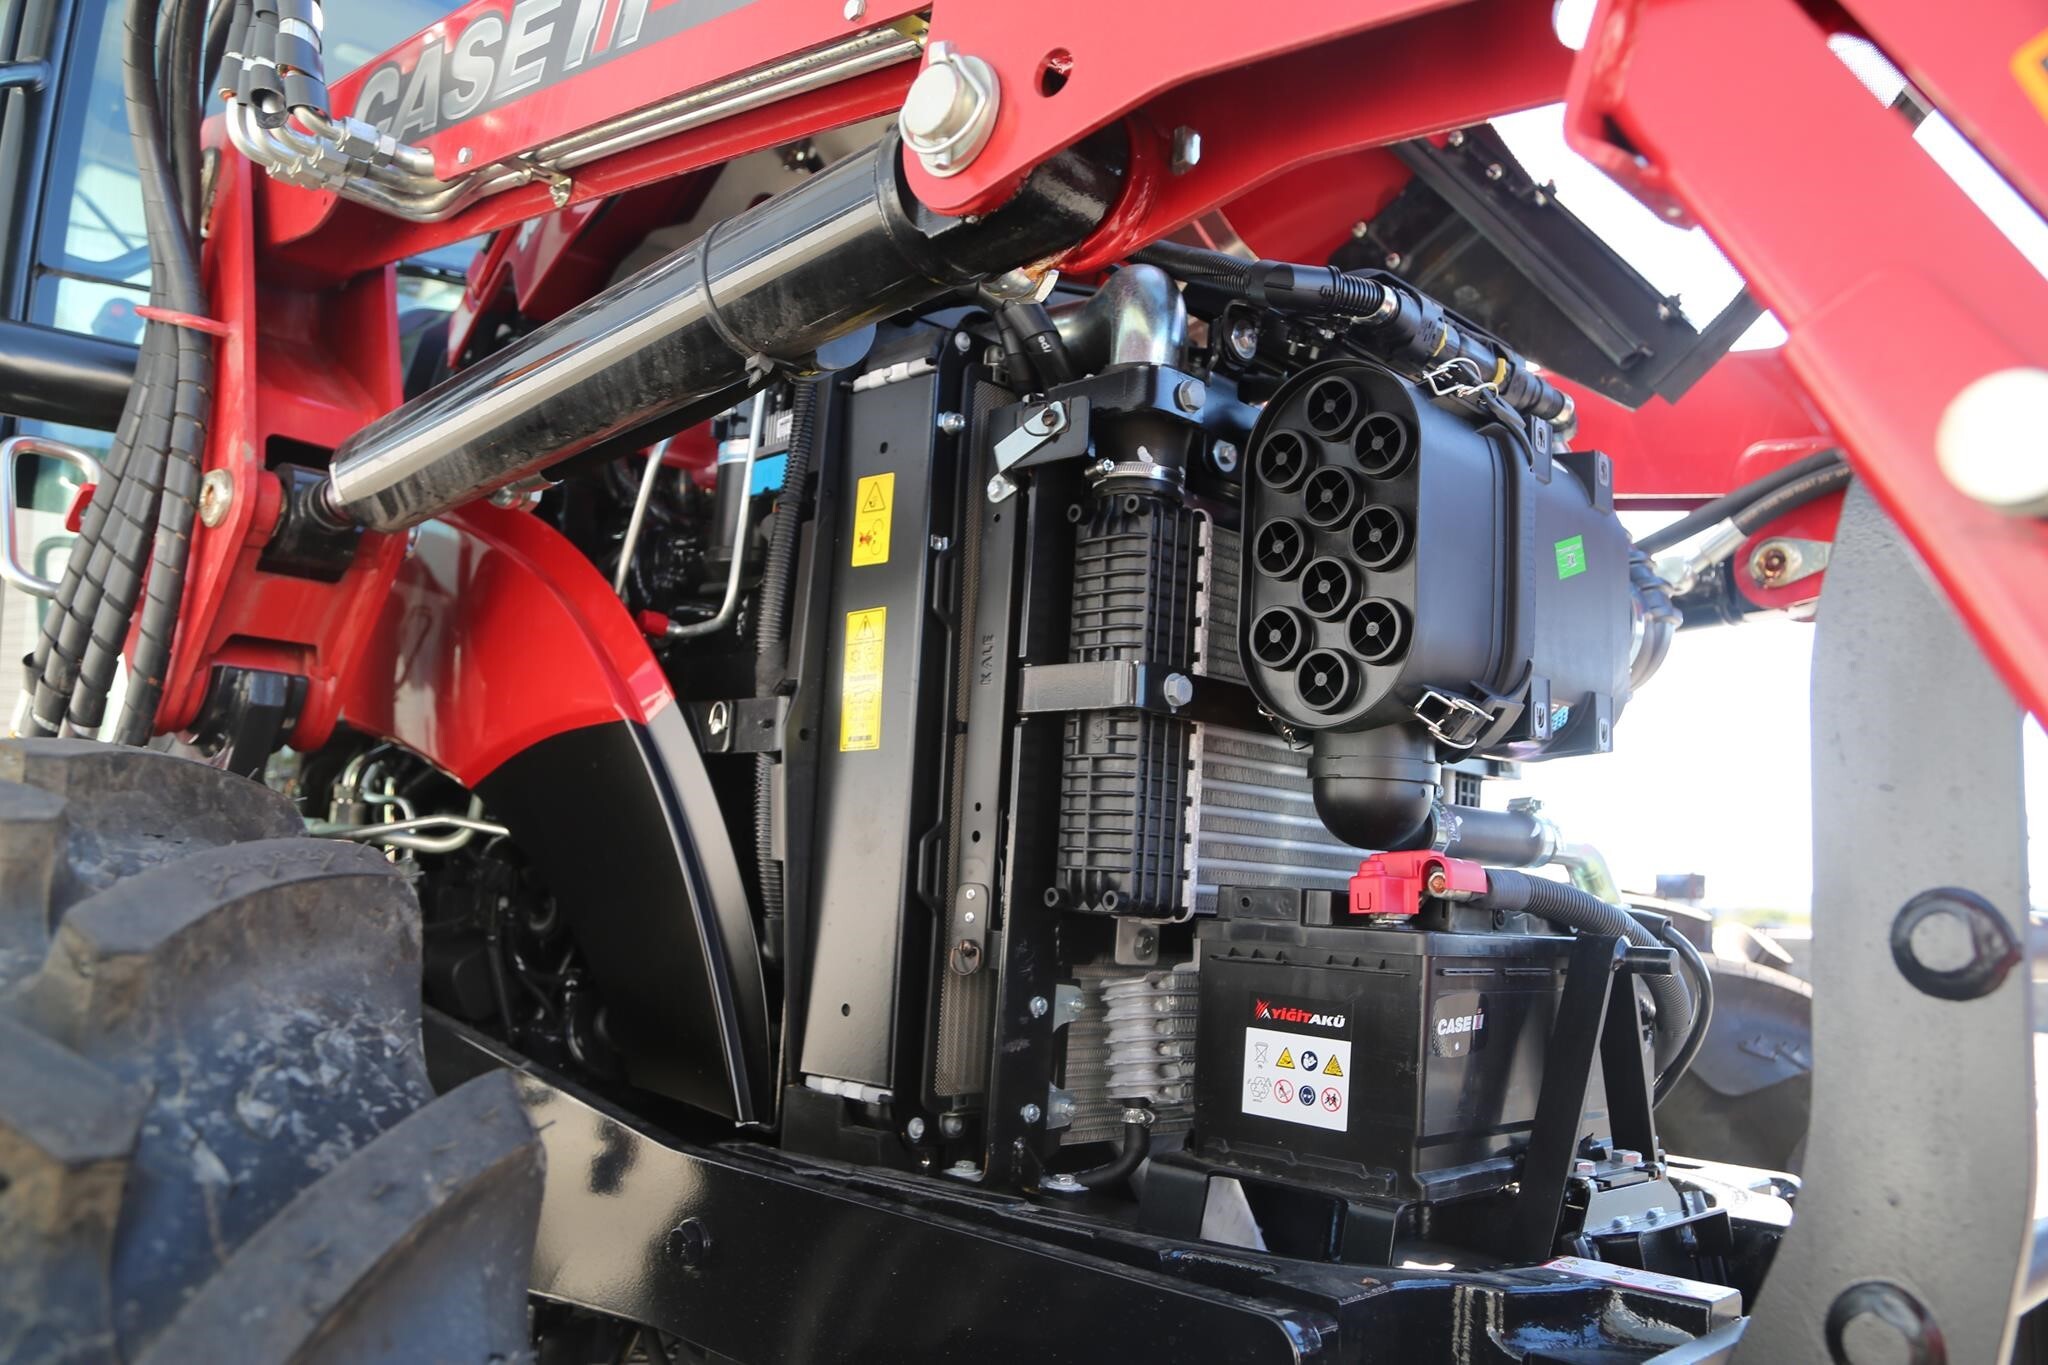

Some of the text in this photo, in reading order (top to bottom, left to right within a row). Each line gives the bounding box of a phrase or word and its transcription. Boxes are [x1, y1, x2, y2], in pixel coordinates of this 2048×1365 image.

[354, 0, 562, 142] CASE
[980, 633, 994, 686] KALE
[1437, 1015, 1472, 1036] CASE
